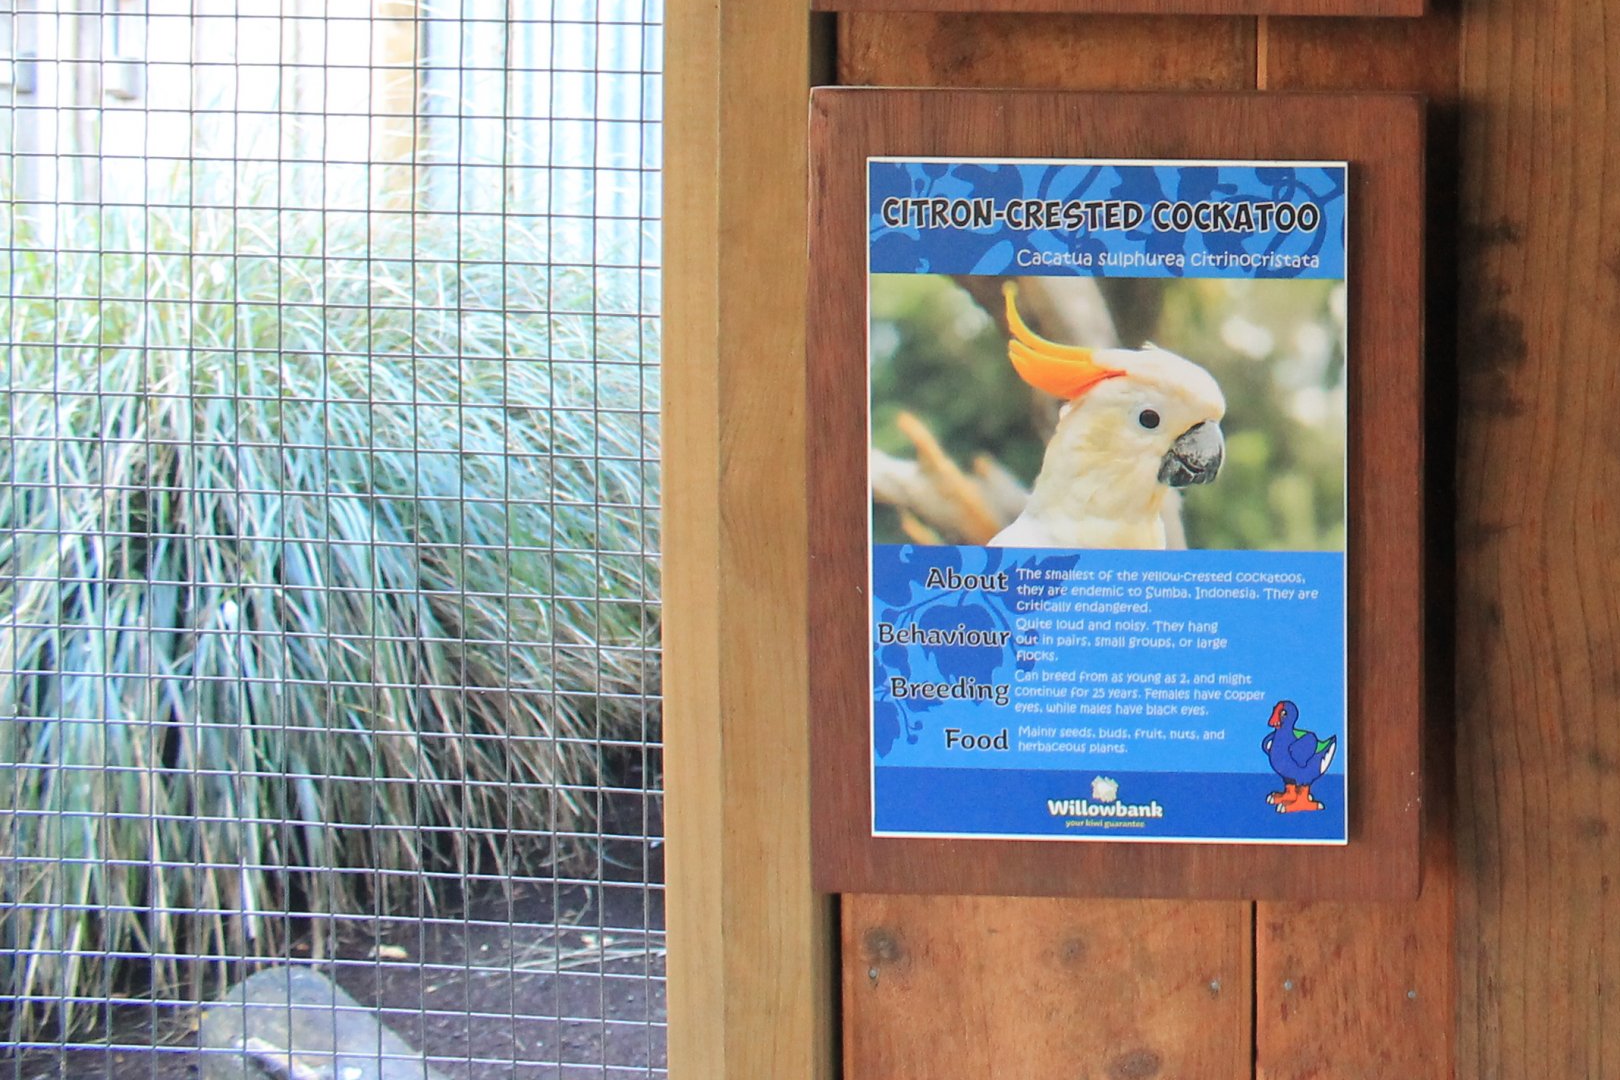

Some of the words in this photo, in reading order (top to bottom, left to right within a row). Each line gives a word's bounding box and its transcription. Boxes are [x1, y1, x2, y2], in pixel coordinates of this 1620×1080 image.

[881, 195, 1145, 233] CITRON-CRESTED
[1151, 200, 1321, 234] COCKATOO
[1016, 248, 1093, 268] Cacatua
[1097, 250, 1185, 269] sulphurea
[1190, 251, 1320, 269] citrinocristata
[925, 566, 1009, 592] About
[1016, 568, 1042, 580] The
[1044, 569, 1096, 581] smallest
[1098, 569, 1114, 581] of
[1116, 570, 1139, 582] the
[1141, 570, 1233, 584] yellow-crested
[1235, 571, 1306, 584] cockatoos,
[1074, 602, 1152, 615] endangered.
[877, 622, 1012, 647] Behaviour
[889, 676, 1010, 707] Breeding
[1014, 686, 1067, 699] continue
[1070, 687, 1089, 699] for
[1091, 687, 1105, 699] 25
[1108, 688, 1142, 701] years.
[1144, 687, 1191, 701] Females
[1193, 688, 1222, 701] have
[1224, 690, 1266, 702] copper
[1014, 703, 1044, 714] eyes,
[1046, 702, 1078, 714] while
[1080, 703, 1113, 715] males
[1115, 703, 1144, 716] have
[1146, 704, 1178, 717] black
[1180, 705, 1209, 717] eyes.
[944, 728, 1009, 751] Food
[1018, 741, 1086, 753] herbaceous
[1089, 742, 1129, 754] plants.
[1047, 799, 1164, 818] Willowbank
[1065, 820, 1084, 828] your
[1085, 819, 1103, 827] kiwi
[1104, 820, 1145, 829] guarantee
